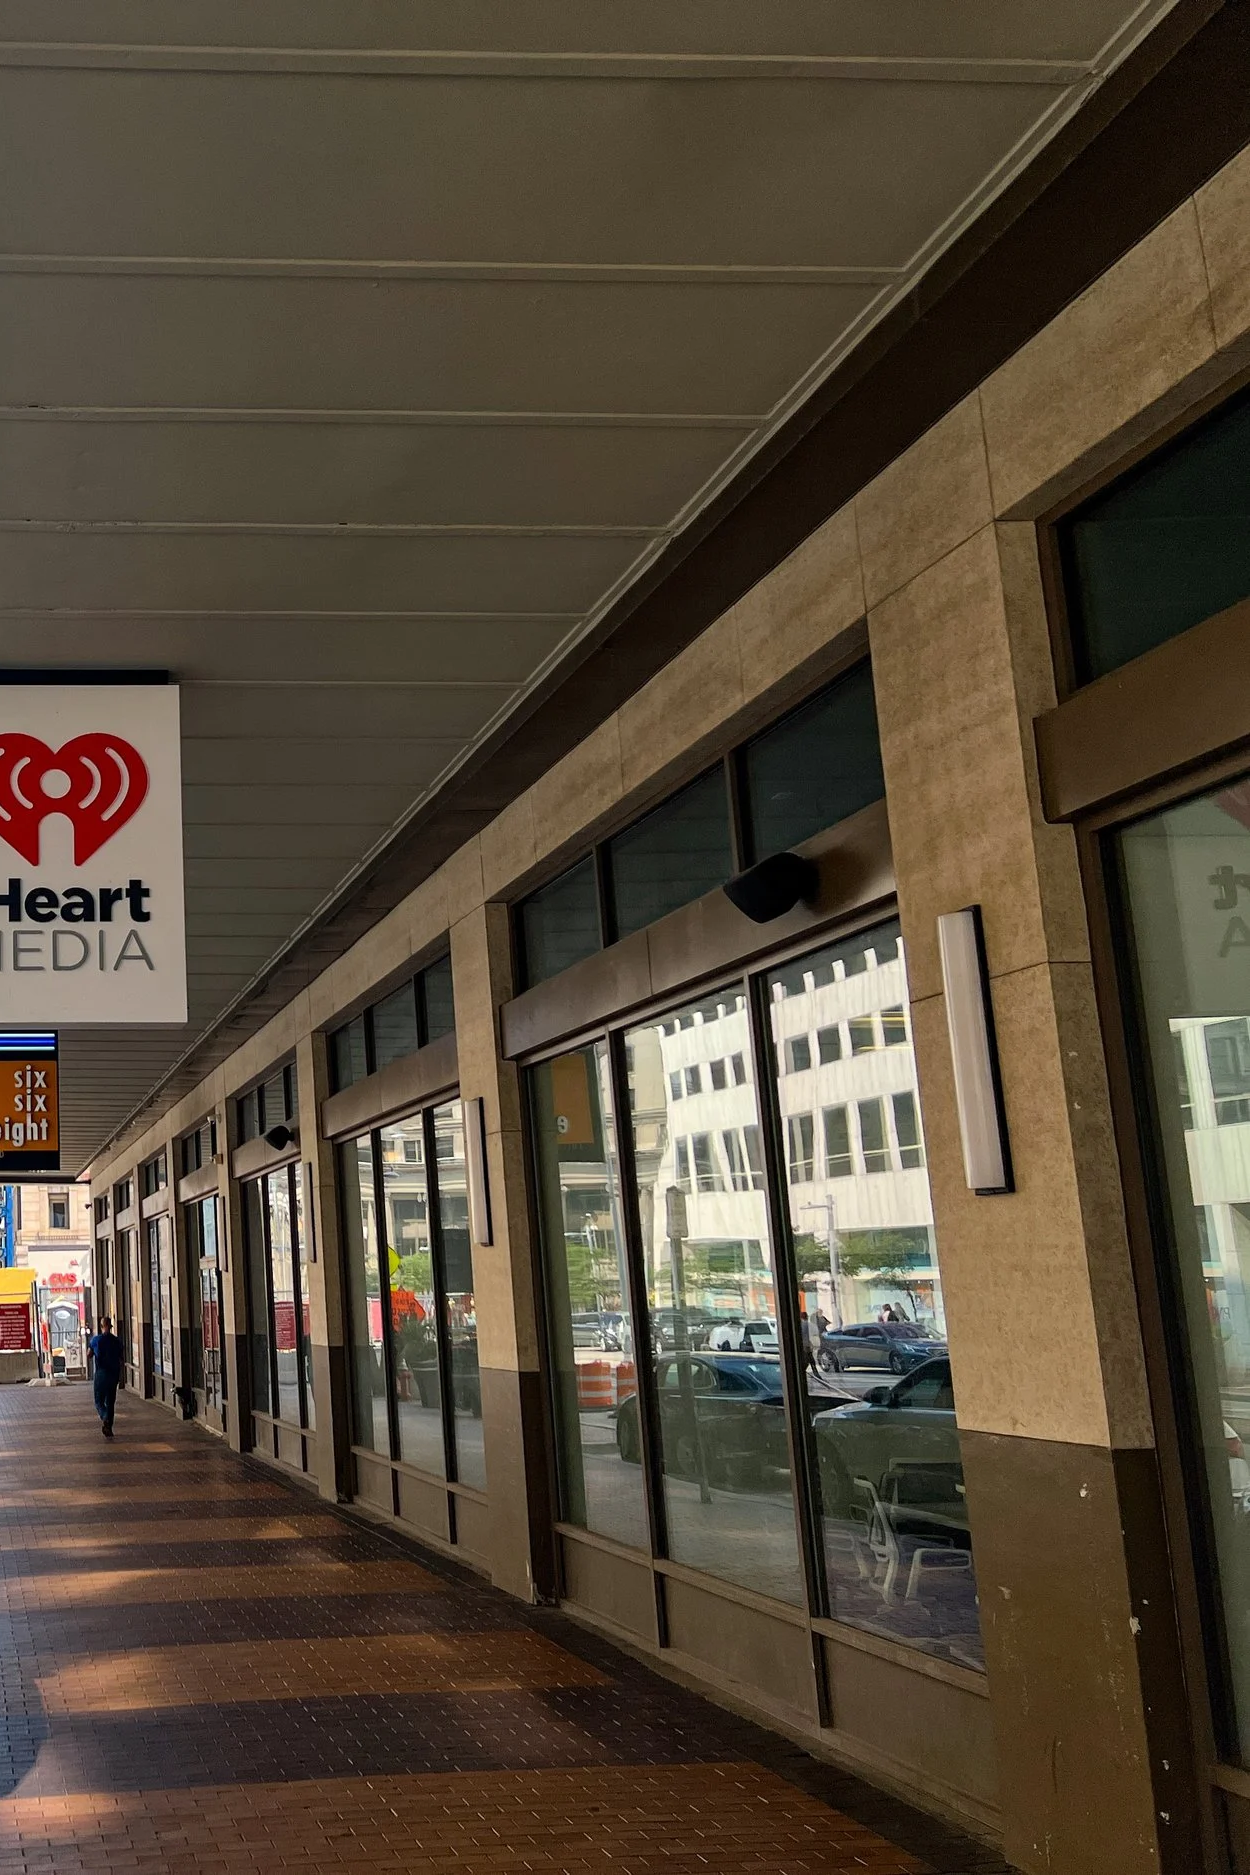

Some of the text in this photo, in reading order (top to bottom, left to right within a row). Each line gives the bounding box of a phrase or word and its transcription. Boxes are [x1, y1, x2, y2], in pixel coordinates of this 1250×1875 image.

[14, 1064, 47, 1088] six
[14, 1088, 47, 1112] six
[49, 1272, 77, 1288] CVS
